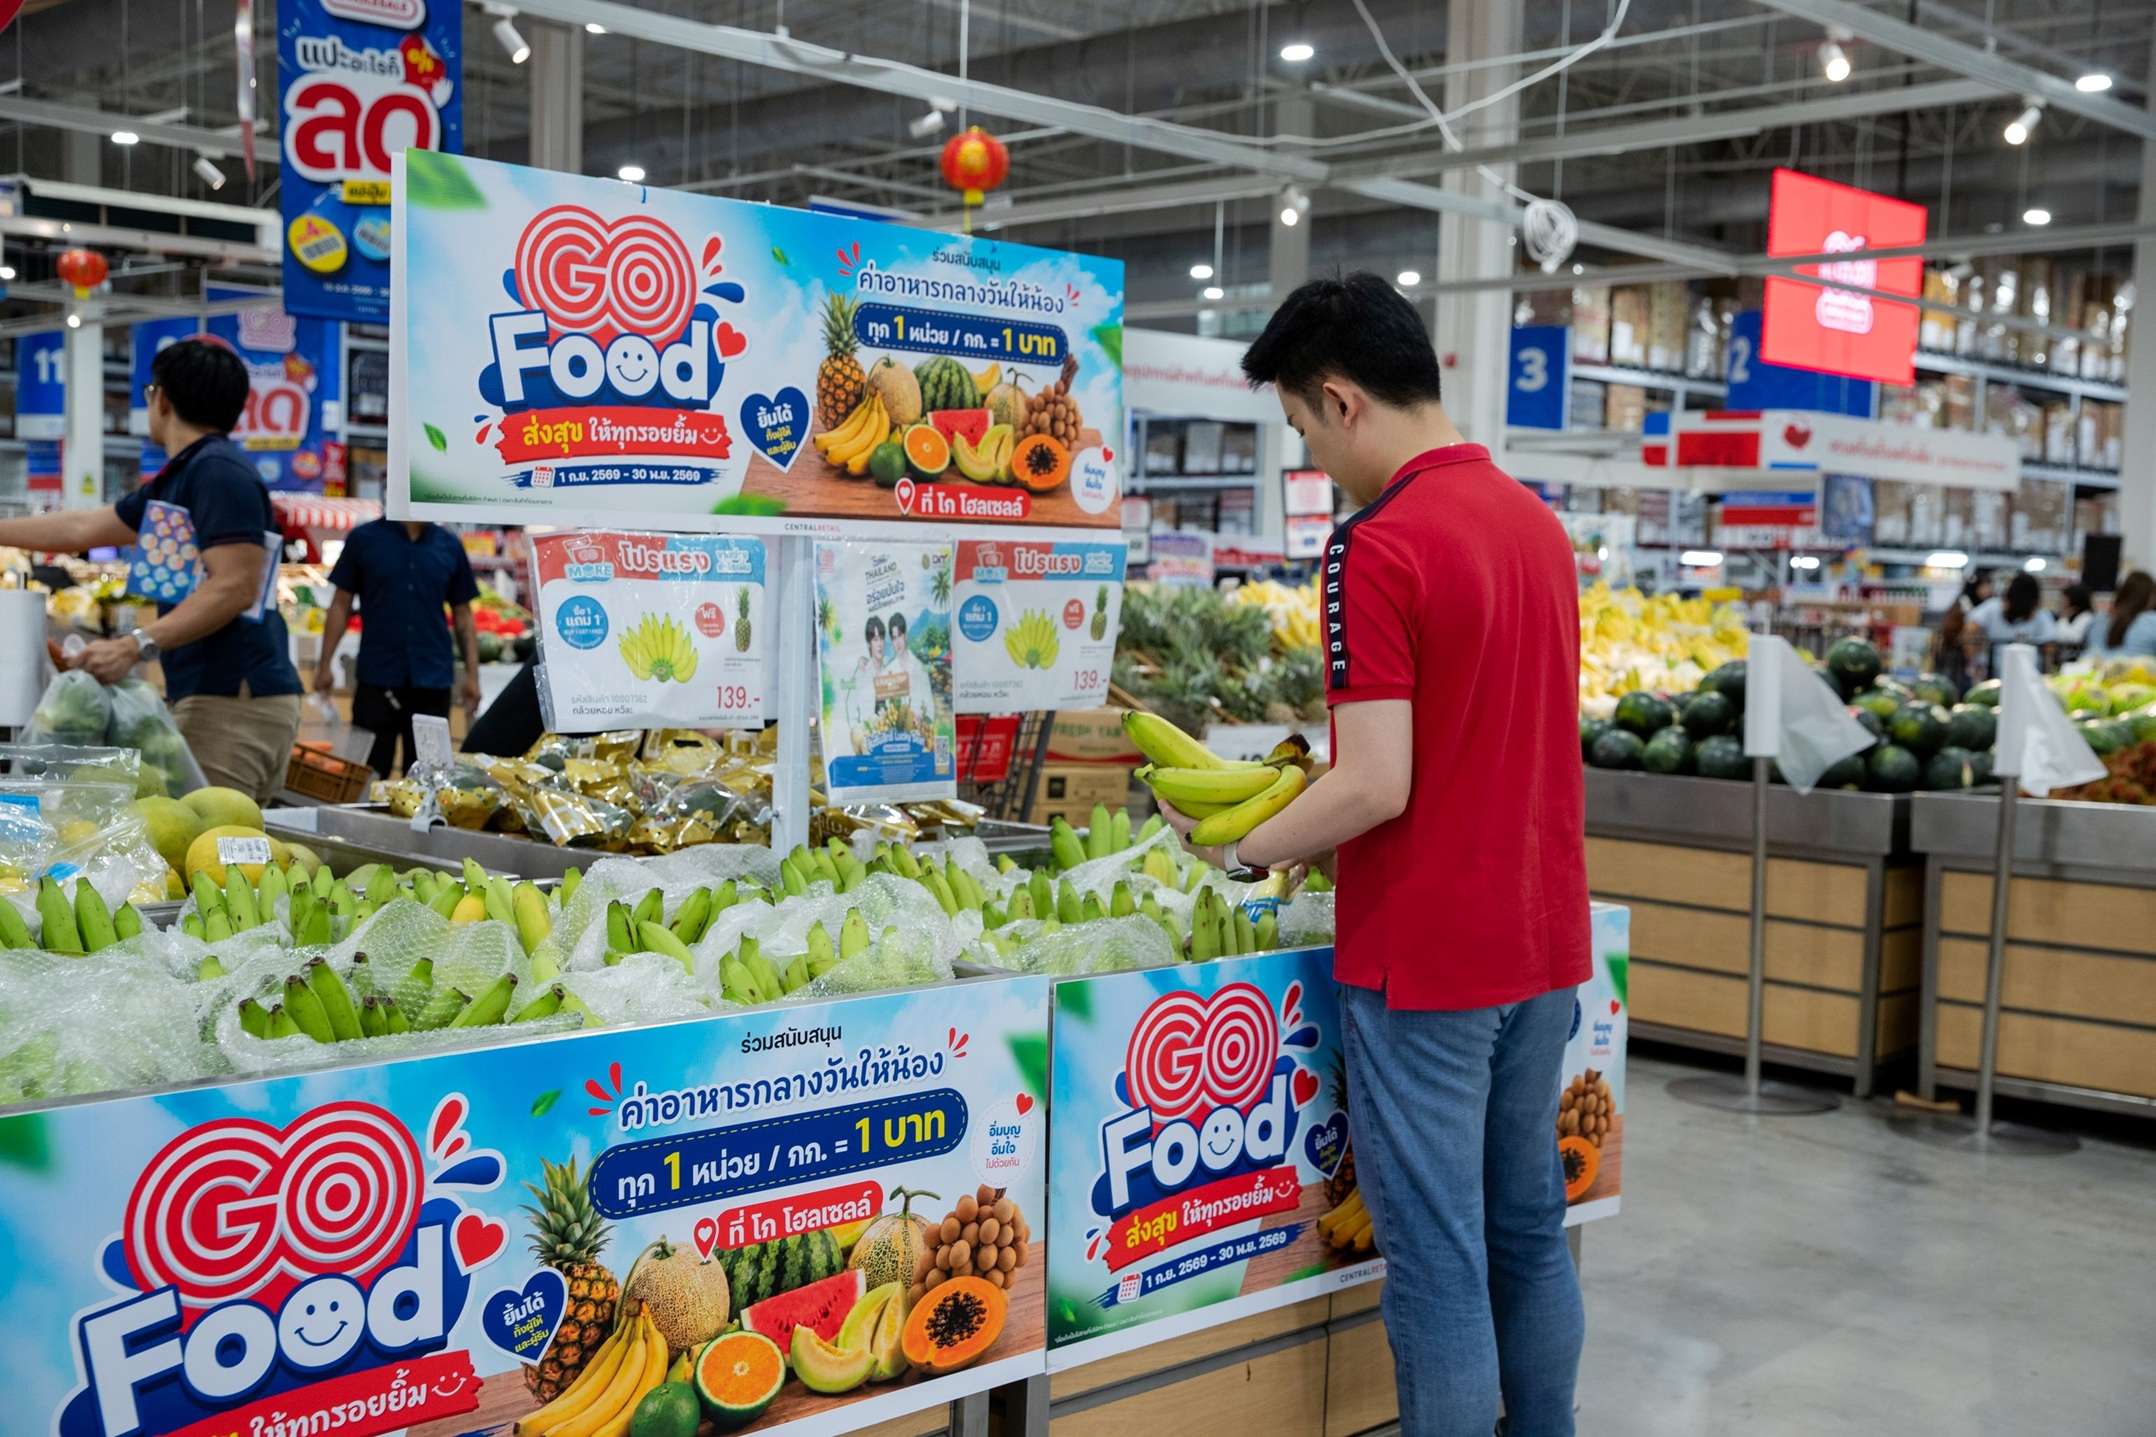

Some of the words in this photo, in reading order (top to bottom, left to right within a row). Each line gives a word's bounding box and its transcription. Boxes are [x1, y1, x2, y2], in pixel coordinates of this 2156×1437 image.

[515, 205, 698, 350] GO
[933, 247, 1001, 275] ร่วมสนับสนุน
[859, 262, 1065, 313] ค่าอาหารกลางวันให้น้อง
[490, 311, 711, 403] Food
[868, 321, 890, 344] ทุก
[893, 315, 904, 340] 1
[909, 322, 949, 345] หน่วย
[952, 330, 961, 346] /
[964, 333, 988, 349] กก.
[991, 338, 999, 348] =
[1003, 328, 1012, 352] 1
[1019, 333, 1057, 357] บาท
[33, 348, 65, 384] 11
[1515, 345, 1549, 393] 3
[522, 415, 584, 454] ส่งสุข
[588, 414, 698, 450] ให้ทุกรอยยิ้ม
[757, 403, 793, 428] ยิ้มได้
[559, 471, 566, 483] 1
[568, 471, 590, 482] ก.ย.
[591, 468, 621, 481] 2569
[632, 468, 648, 480] 30
[649, 469, 671, 481] พ.ย.
[672, 469, 701, 481] 2569
[921, 486, 934, 513] ที่
[937, 491, 956, 514] โก
[960, 493, 1024, 517] โฮลเซลล์
[620, 541, 710, 572] โปรแรง
[1014, 549, 1081, 572] โปรแรง
[593, 614, 601, 626] 1
[1327, 544, 1346, 671] COURAGE
[716, 686, 760, 709] 139.-
[741, 1024, 843, 1054] ร่วมสนับสนุน
[1125, 982, 1280, 1122] GO
[622, 1044, 945, 1127] ค่าอาหารกลางวันให้น้อง
[989, 1120, 1021, 1140] อิ่มบุญ
[991, 1139, 1016, 1156] อิ่มใจ
[1103, 1074, 1288, 1210] Food
[618, 1173, 656, 1208] ทุก
[663, 1152, 681, 1191] 1
[692, 1148, 761, 1187] หน่วย
[768, 1145, 781, 1172] /
[788, 1141, 827, 1168] กก.
[834, 1139, 848, 1154] =
[856, 1117, 871, 1154] 1
[884, 1108, 946, 1148] บาท
[123, 1100, 425, 1322] GO
[729, 1208, 745, 1246] ที่
[752, 1214, 777, 1241] โก
[783, 1191, 873, 1237] โฮลเซลล์
[1126, 1210, 1178, 1248] ส่งสุข
[1182, 1175, 1274, 1227] ให้ทุกรอยยิ้ม
[1145, 1275, 1152, 1288] 1
[1155, 1268, 1176, 1284] ก.ย.
[1178, 1254, 1208, 1275] 2569
[1219, 1246, 1234, 1261] 30
[1236, 1242, 1257, 1256] พ.ย.
[1258, 1231, 1287, 1248] 2569
[503, 1291, 545, 1326] ยิ้มได้
[82, 1224, 448, 1437] Food
